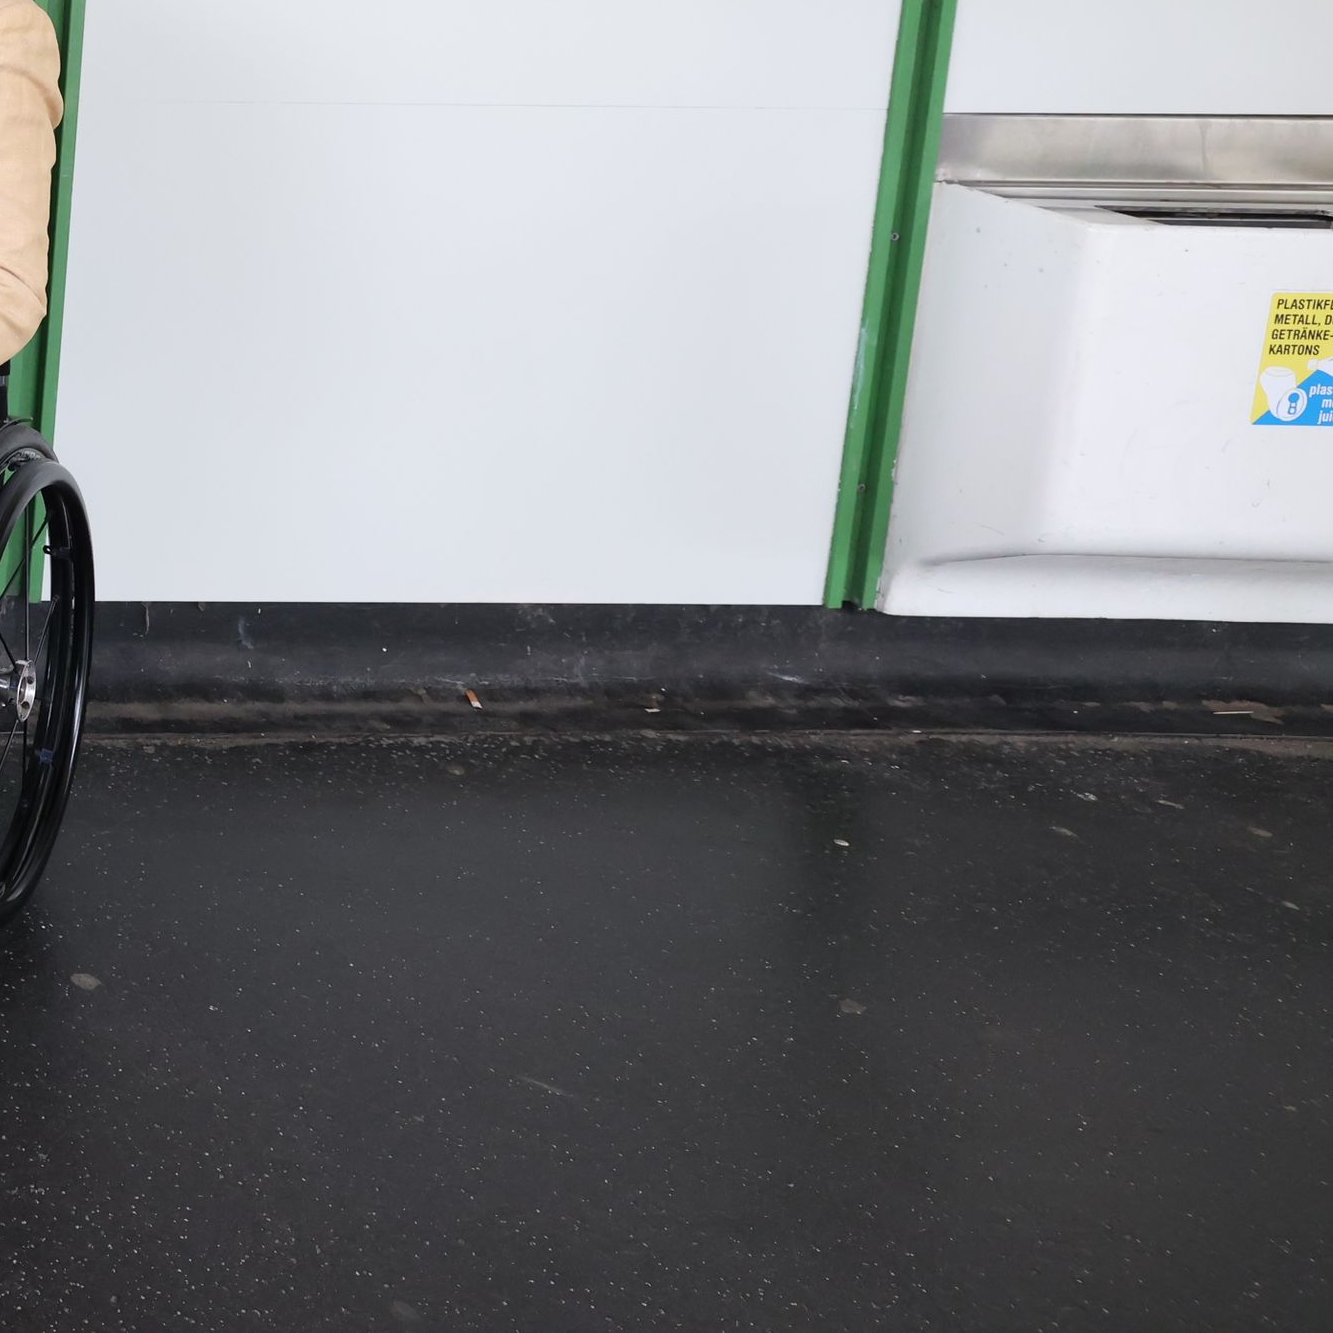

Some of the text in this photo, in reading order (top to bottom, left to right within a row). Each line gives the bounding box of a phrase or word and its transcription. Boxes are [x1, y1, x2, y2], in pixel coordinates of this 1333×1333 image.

[1274, 314, 1321, 326] METALL,
[1271, 327, 1333, 341] GETRÄNKE-
[1268, 344, 1320, 356] KARTONS
[1317, 410, 1333, 425] jui
